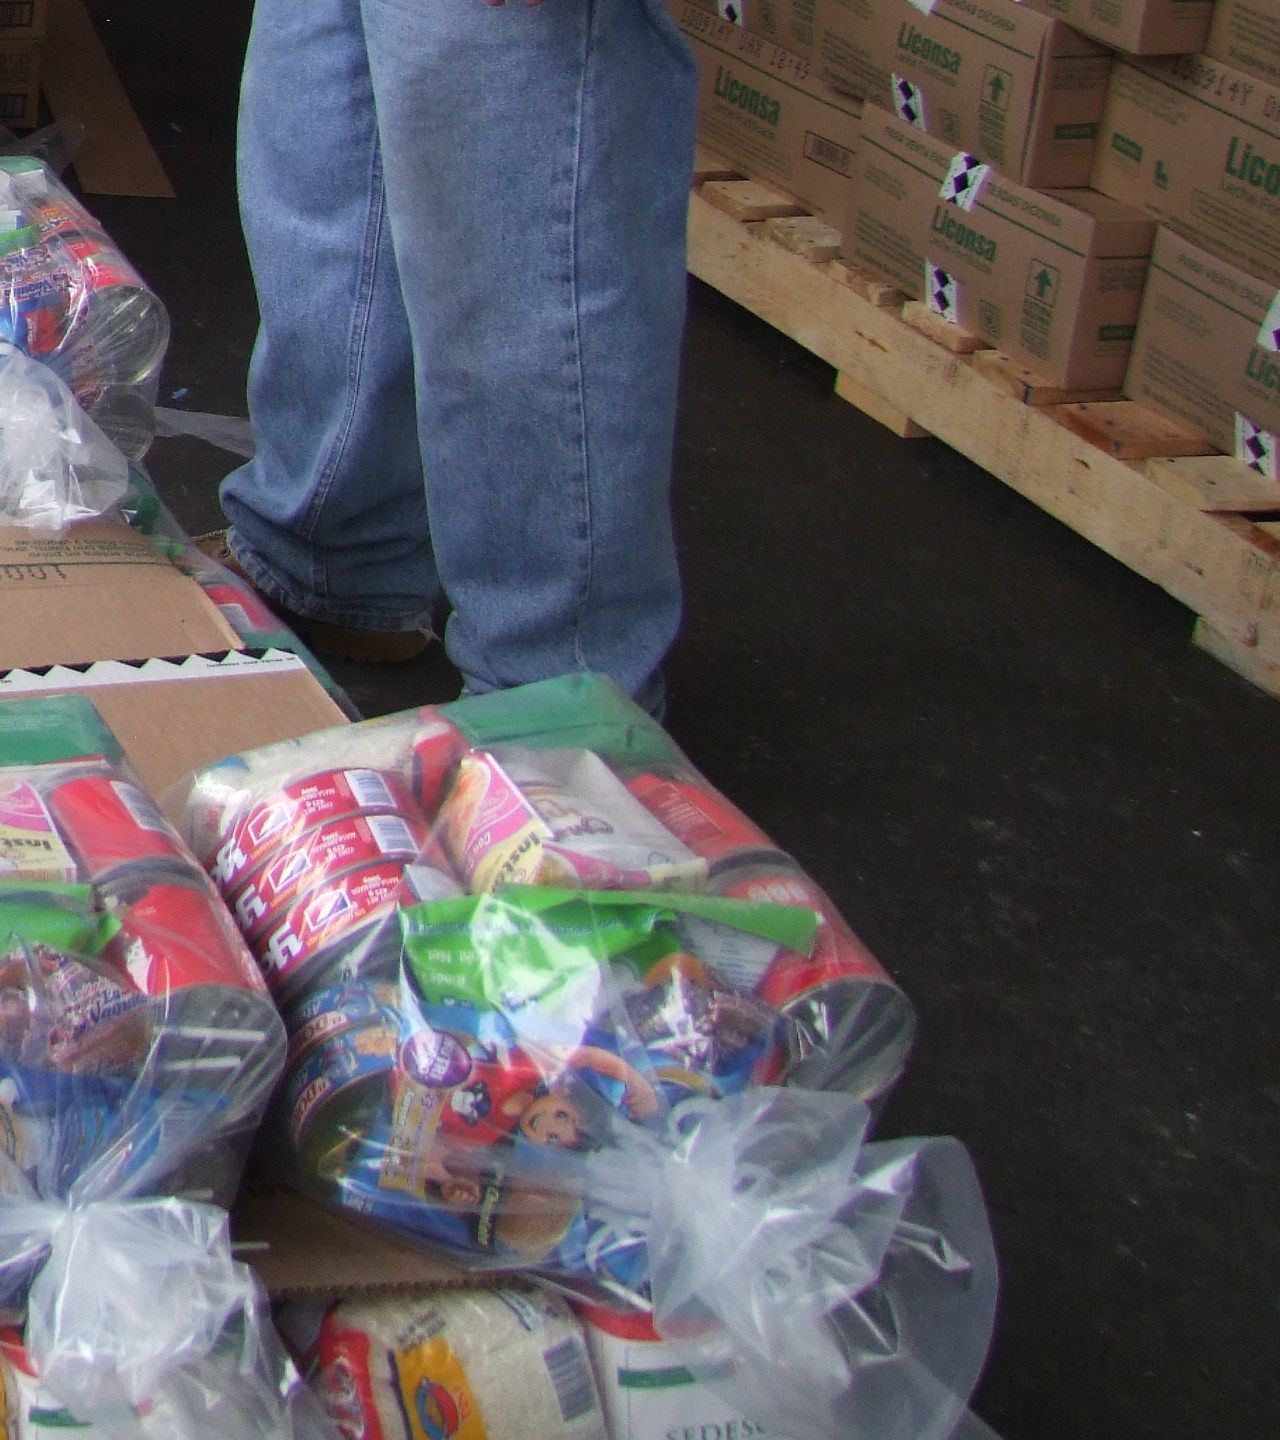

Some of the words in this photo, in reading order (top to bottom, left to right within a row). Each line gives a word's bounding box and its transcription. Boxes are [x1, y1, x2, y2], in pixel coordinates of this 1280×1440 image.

[898, 21, 962, 74] Liconsa
[716, 66, 782, 126] Liconsa
[931, 205, 997, 260] Liconsa
